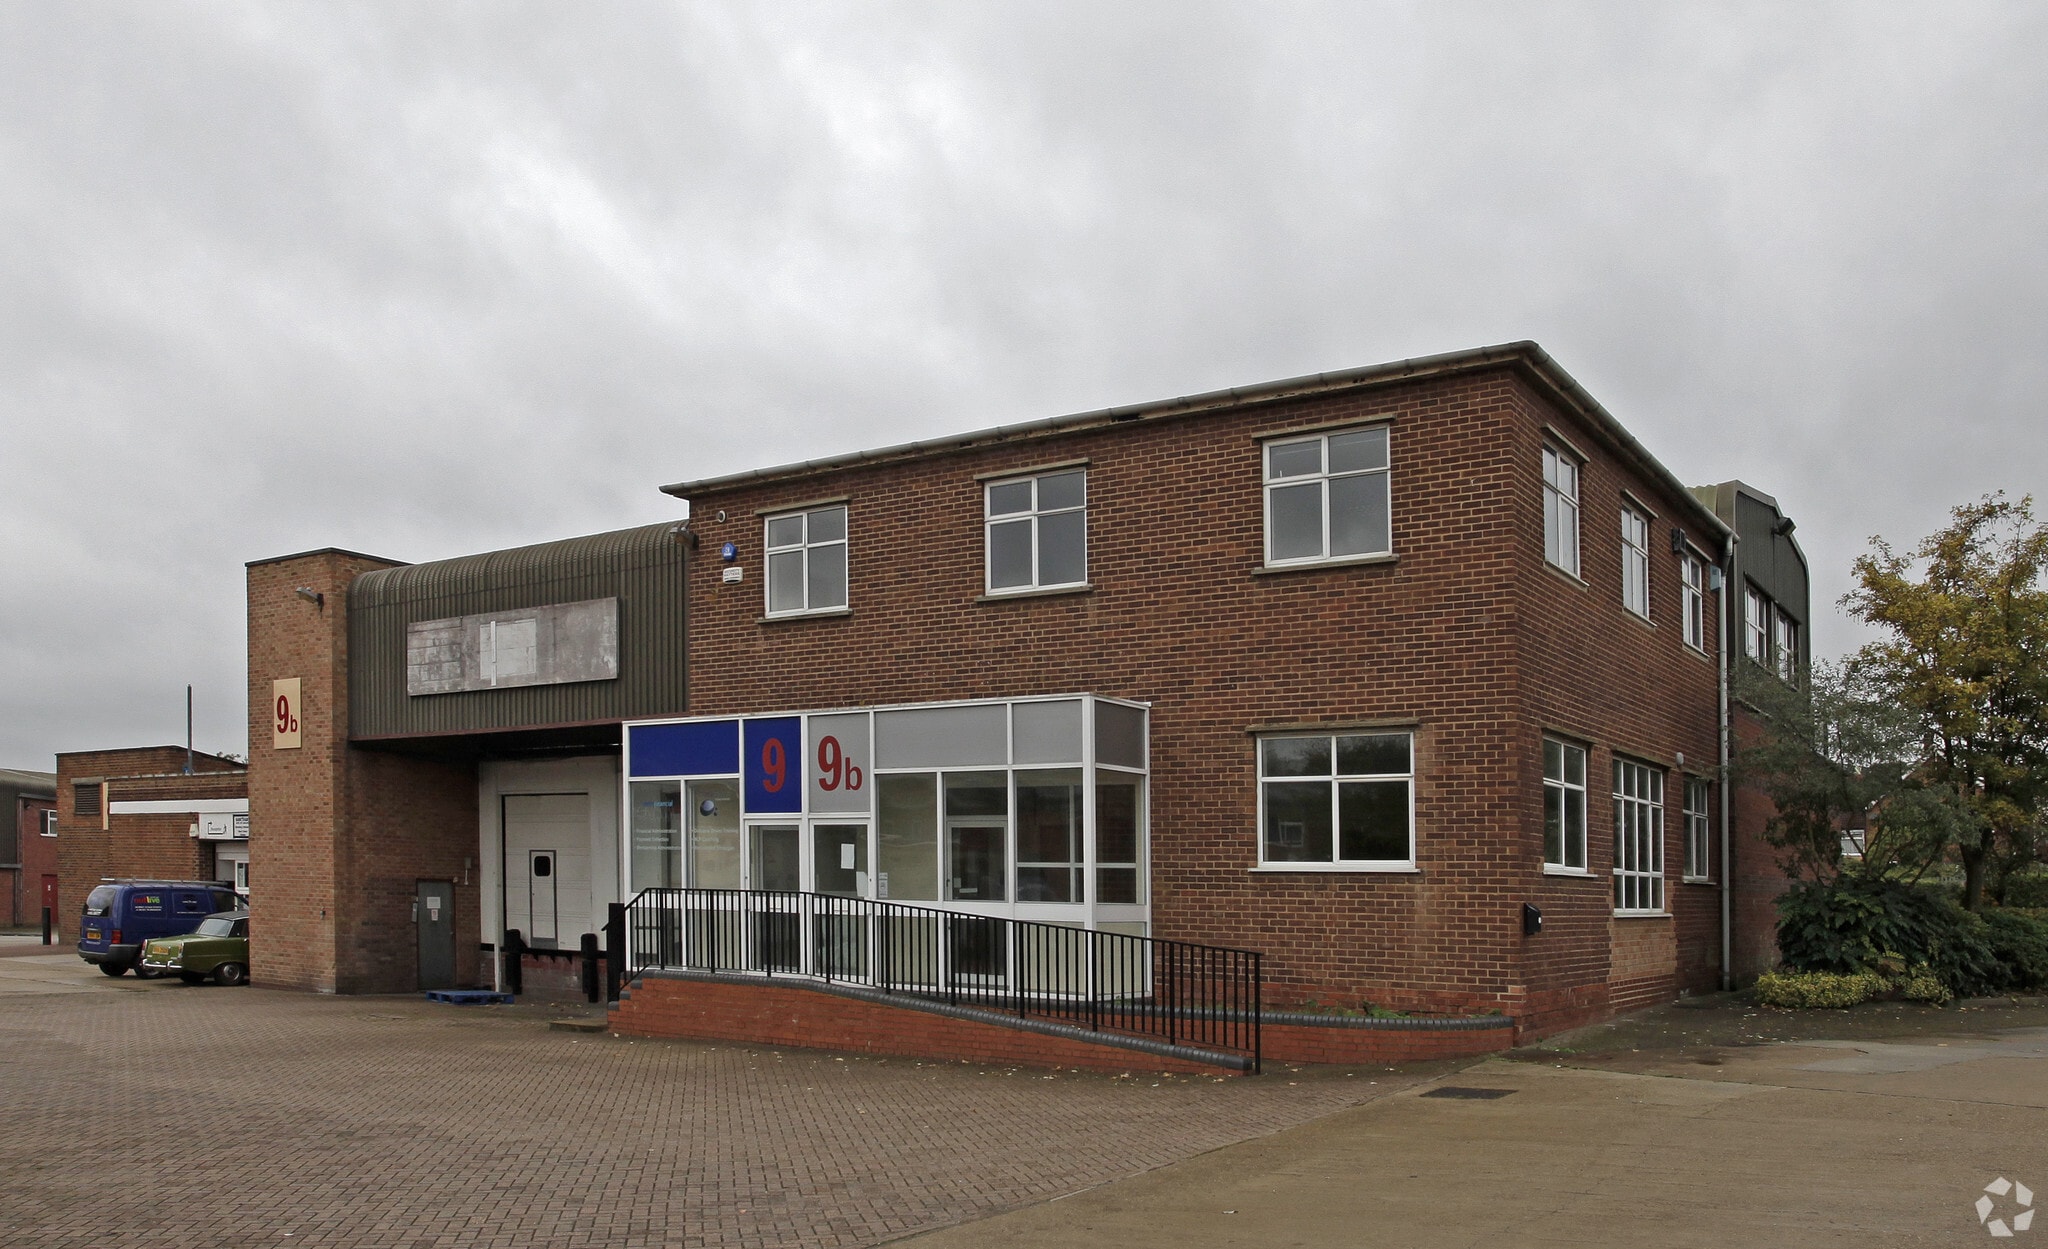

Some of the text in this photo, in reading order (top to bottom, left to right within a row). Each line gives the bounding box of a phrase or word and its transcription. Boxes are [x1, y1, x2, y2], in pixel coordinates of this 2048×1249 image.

[276, 695, 298, 734] 9b
[762, 737, 786, 793] 9
[818, 735, 863, 792] 9b
